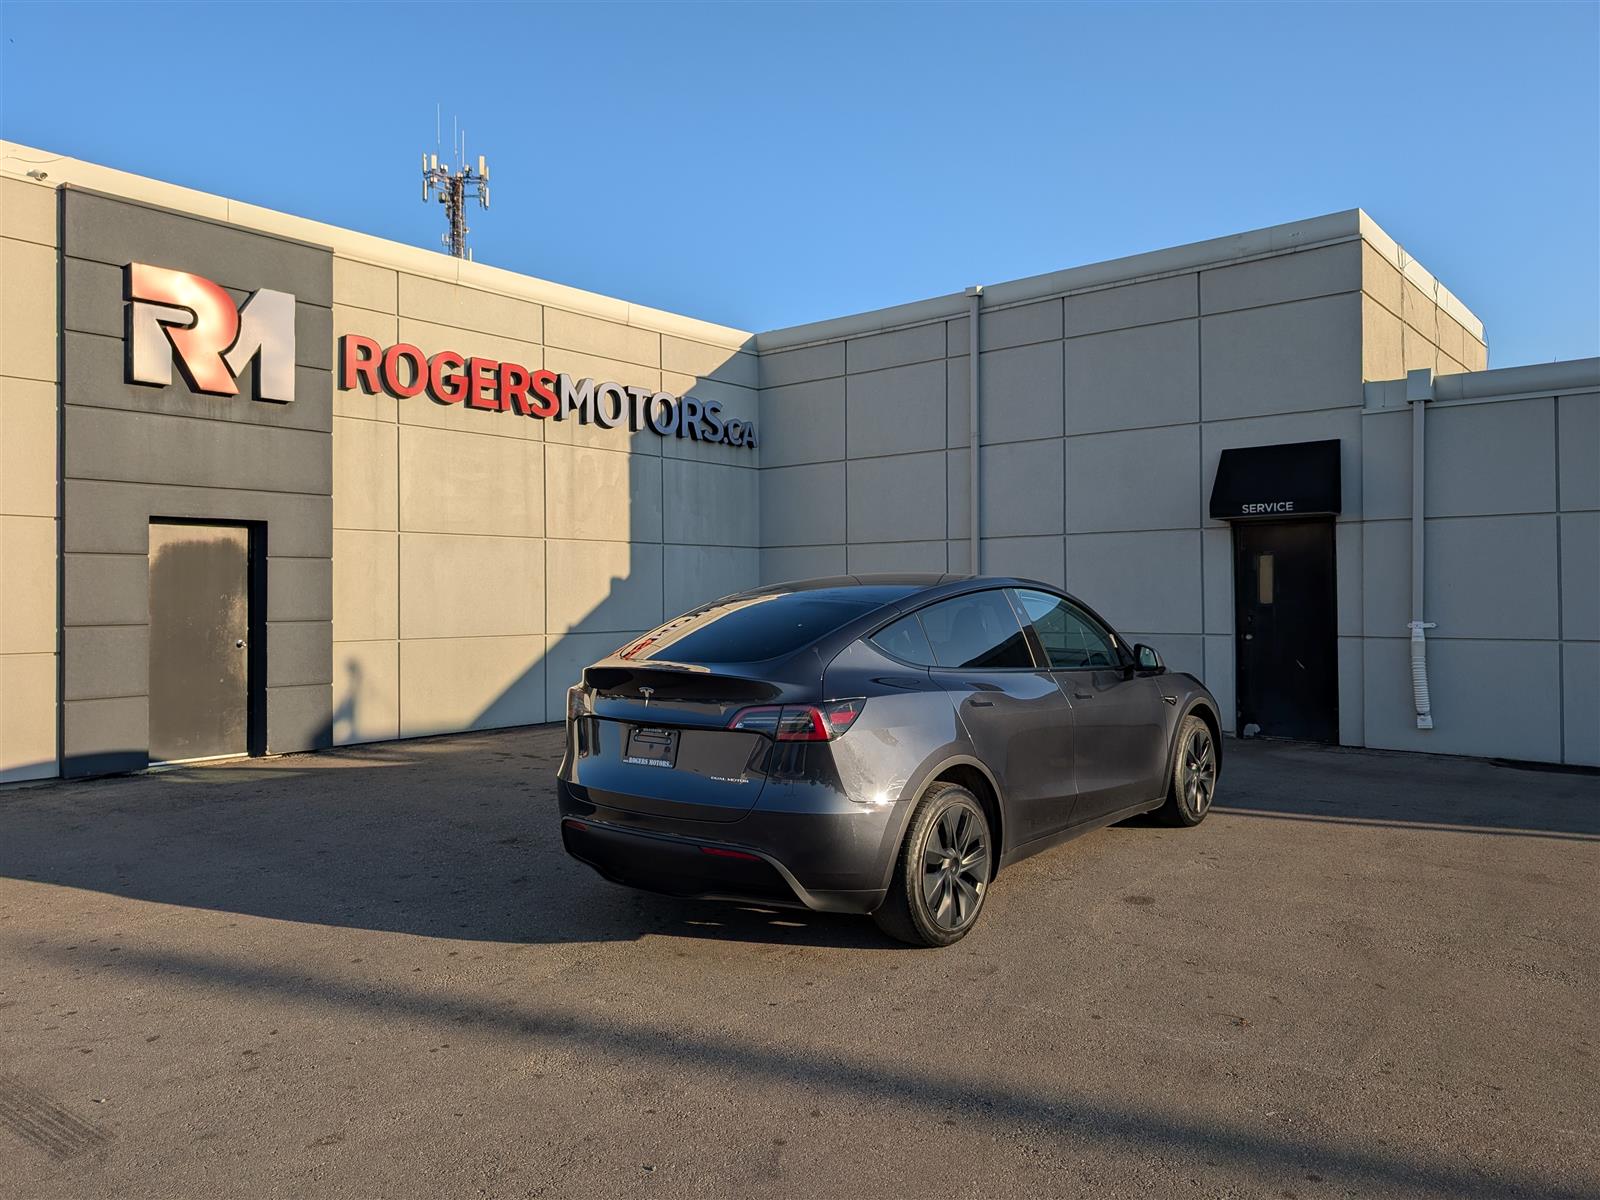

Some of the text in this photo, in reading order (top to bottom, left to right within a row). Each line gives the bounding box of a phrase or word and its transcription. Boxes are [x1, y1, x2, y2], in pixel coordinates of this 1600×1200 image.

[125, 262, 296, 403] RM
[1241, 501, 1294, 514] SERVICE
[628, 756, 649, 765] ROGERS
[648, 759, 670, 767] MOTORS
